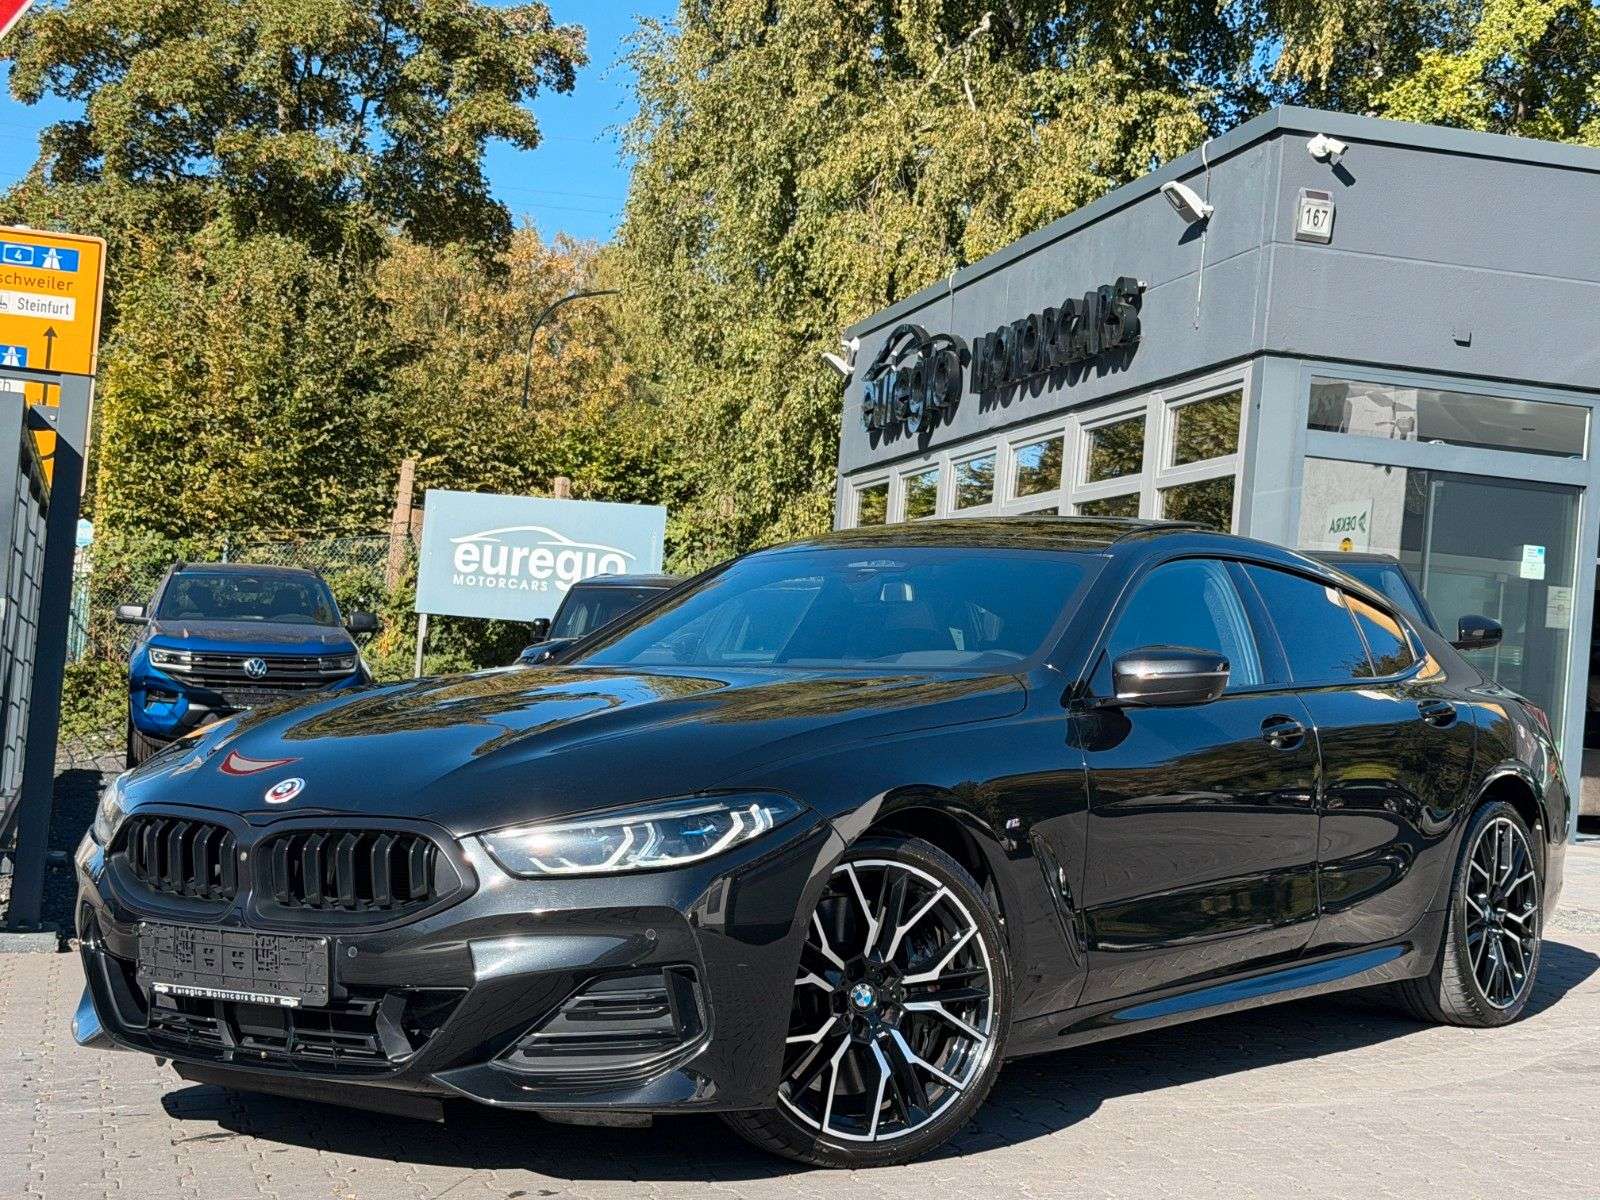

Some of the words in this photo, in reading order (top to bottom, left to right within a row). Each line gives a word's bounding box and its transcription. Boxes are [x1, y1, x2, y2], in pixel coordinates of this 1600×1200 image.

[1306, 207, 1329, 227] 167
[14, 249, 23, 261] 4
[17, 297, 70, 315] Steinfurt
[453, 542, 627, 591] euregio
[452, 574, 549, 592] MOTORCARS
